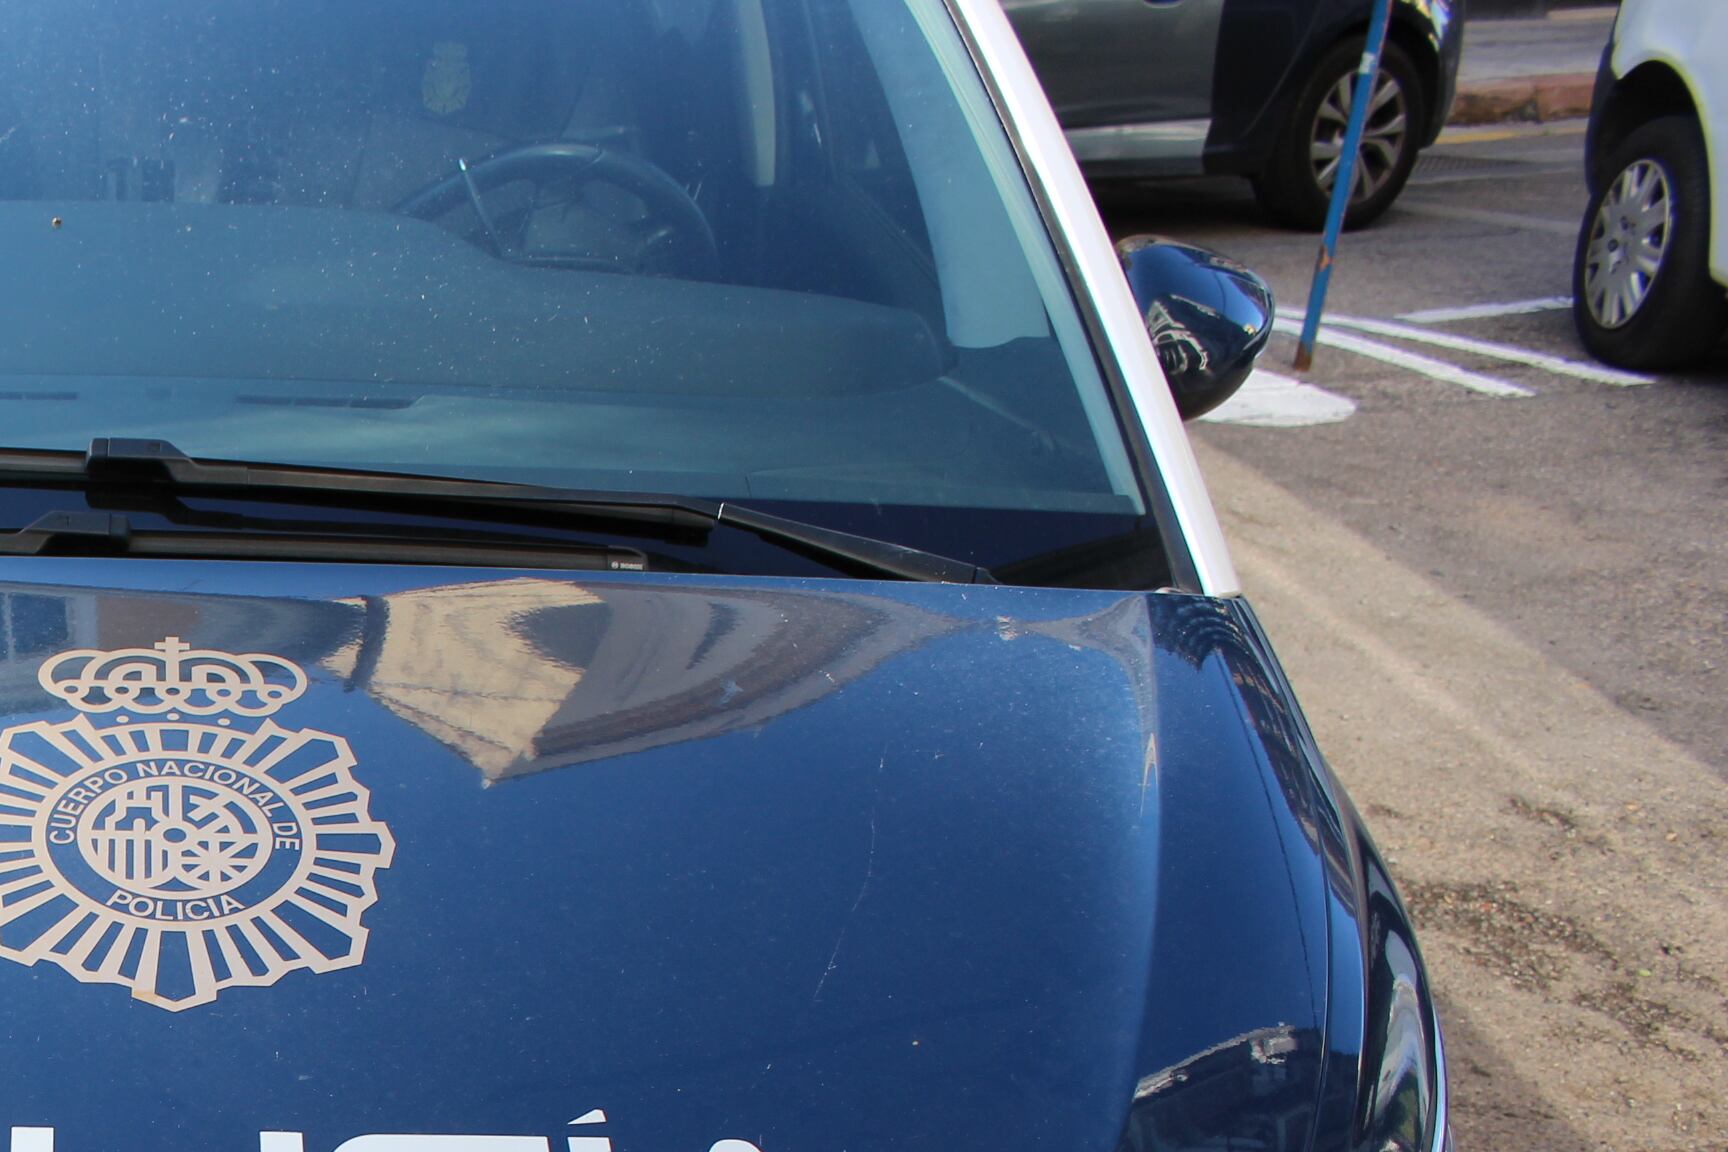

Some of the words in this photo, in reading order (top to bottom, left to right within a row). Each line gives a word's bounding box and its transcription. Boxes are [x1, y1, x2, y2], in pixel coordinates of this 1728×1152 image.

[49, 768, 128, 845] CUERPO
[136, 761, 285, 818] NACIONAL
[272, 822, 301, 851] DE
[105, 889, 246, 920] POLICIA
